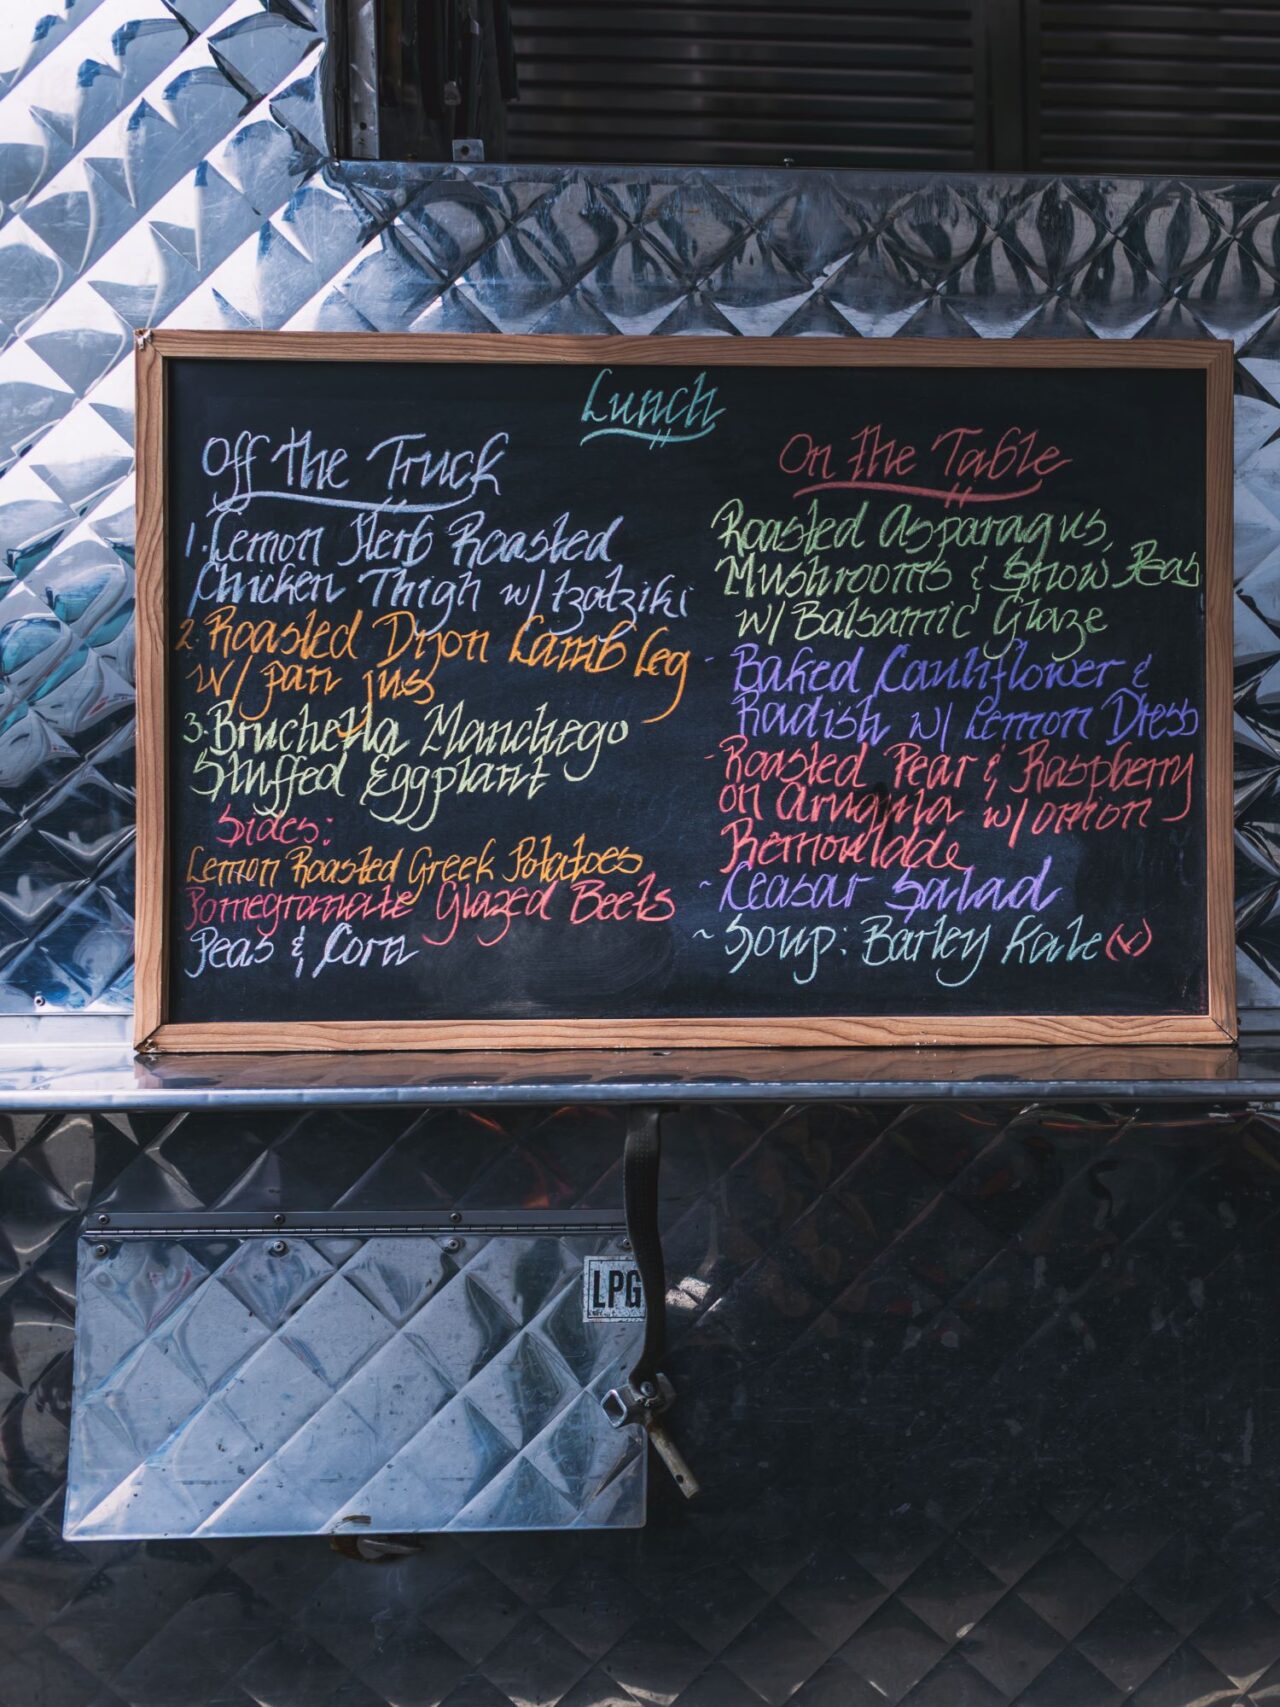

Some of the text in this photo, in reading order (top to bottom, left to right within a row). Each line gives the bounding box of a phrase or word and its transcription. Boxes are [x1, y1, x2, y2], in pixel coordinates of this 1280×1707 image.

[581, 368, 728, 429] Lunch
[202, 427, 509, 514] Off the Truck
[779, 433, 836, 479] On
[931, 427, 1073, 480] Table
[338, 511, 435, 567] Herb
[447, 511, 624, 568] Roasted
[711, 498, 868, 557] Roasted
[187, 562, 347, 617] Chicken
[358, 566, 482, 636] Thigh
[714, 552, 952, 598] Mushrooms
[990, 547, 1109, 602] Snow
[1112, 540, 1200, 589] Peas
[791, 597, 974, 641] Balsamic
[984, 595, 1108, 661] Glaze
[203, 605, 358, 660] Roasted
[372, 610, 490, 692] Dijon
[509, 615, 637, 673] Lamb
[633, 627, 692, 723] Leg
[731, 643, 865, 695] Baked
[873, 638, 1126, 712] Cauliflower
[420, 700, 629, 782] Manchego
[731, 689, 892, 746] Radish
[965, 696, 1094, 741] Lemon
[1101, 688, 1199, 745] Dress
[190, 749, 551, 832] Stuffed Eggplant
[719, 734, 867, 788] Roasted
[884, 743, 979, 789] Pear
[1009, 739, 1194, 822] Raspberry
[719, 783, 763, 820] on
[216, 803, 335, 847] Sides:
[186, 833, 645, 905] Lemon Roasted Greek Potatoes
[719, 855, 1062, 923] Ceasar Salad
[184, 872, 676, 946] Pomegranate Glazed Beets
[184, 927, 275, 979] Peas
[312, 923, 420, 979] Corn
[725, 913, 848, 984] Soup:
[860, 914, 991, 987] Barley
[1001, 914, 1102, 964] Kale
[593, 1269, 642, 1309] LPG
